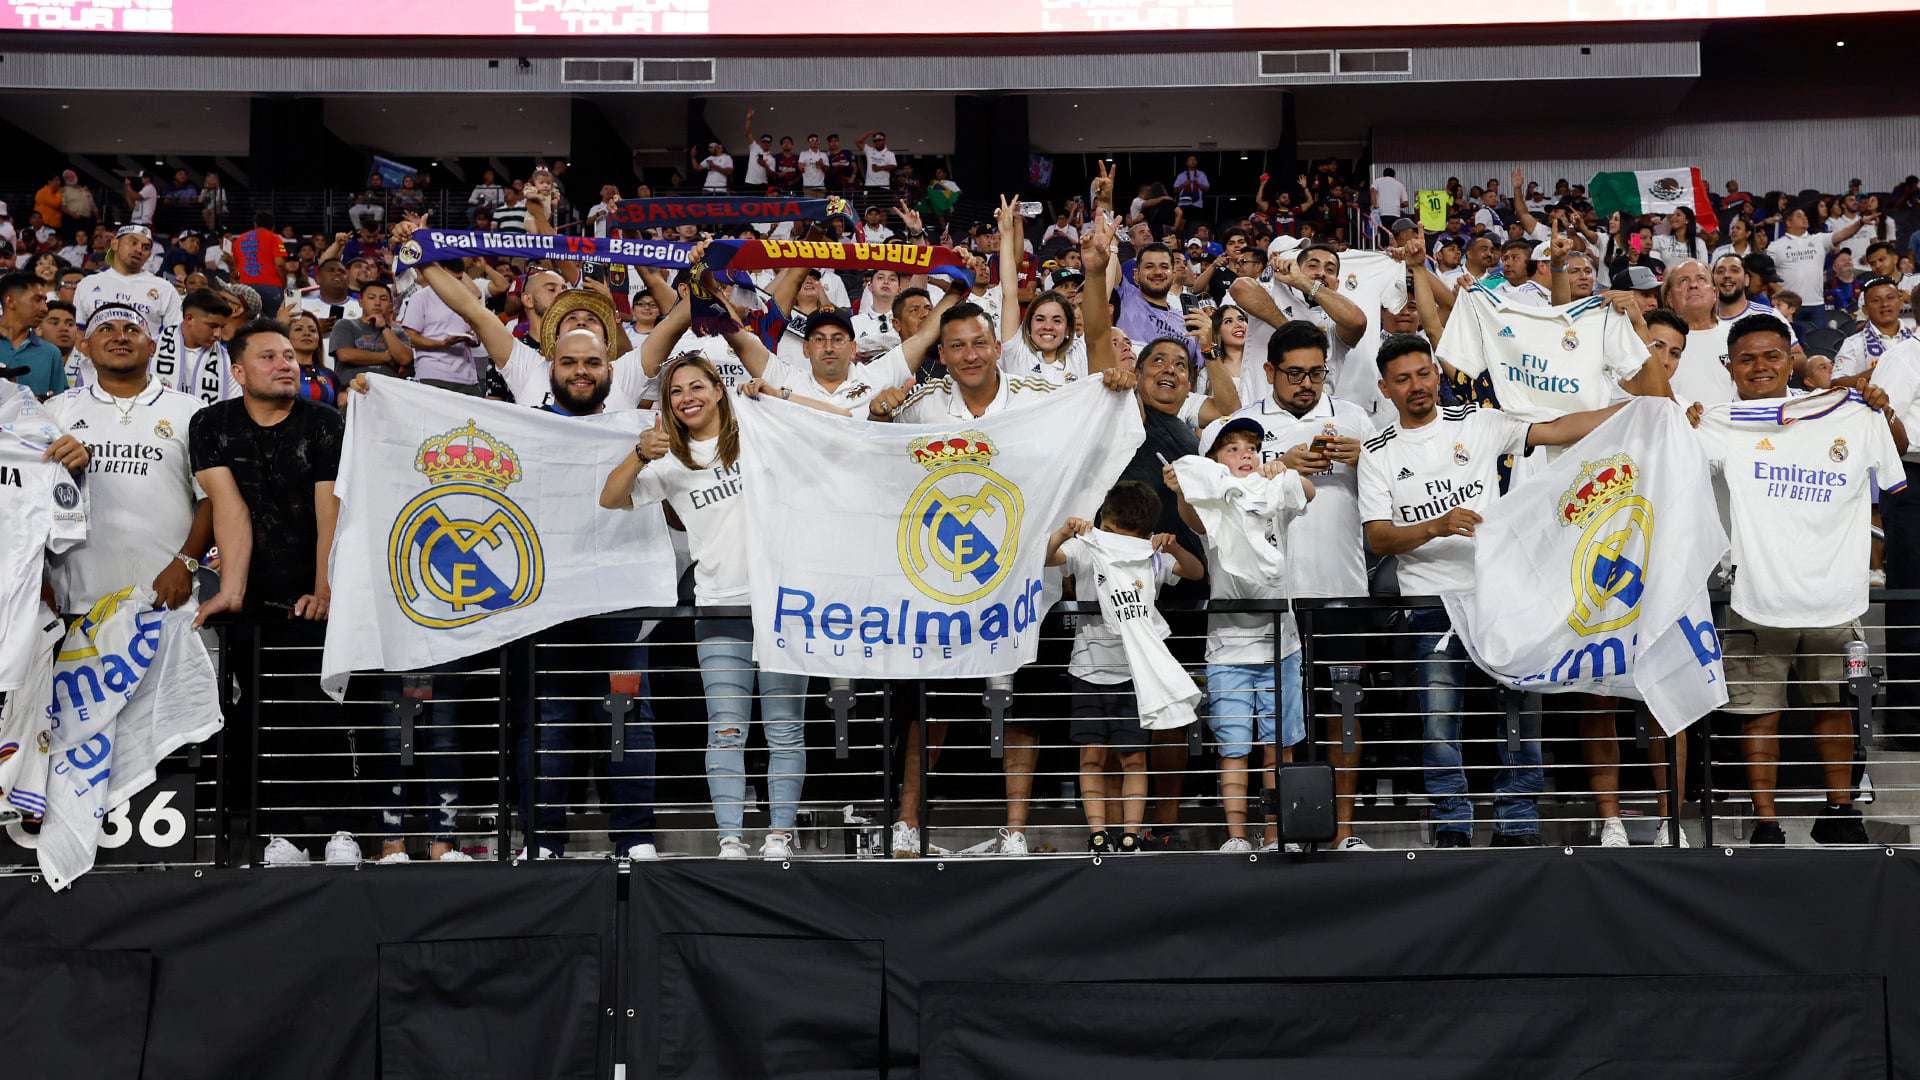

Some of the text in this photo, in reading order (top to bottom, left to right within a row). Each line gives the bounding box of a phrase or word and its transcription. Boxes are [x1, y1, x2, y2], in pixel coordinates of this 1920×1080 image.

[16, 6, 113, 29] TOUR
[560, 12, 652, 32] TOUR
[1428, 198, 1441, 209] 10
[430, 231, 478, 248] Real
[482, 232, 554, 249] Madrid
[566, 236, 597, 255] VS
[1522, 353, 1548, 372] Fly
[1500, 362, 1580, 394] mirates
[83, 440, 163, 461] mirates
[104, 460, 149, 476] BETTER
[1754, 461, 1847, 487] Emirates
[1424, 478, 1452, 496] Fly
[1768, 482, 1832, 503] FLY BETTER
[1399, 479, 1484, 523] Emirates
[776, 638, 873, 658] CLUB
[912, 646, 953, 659] DE
